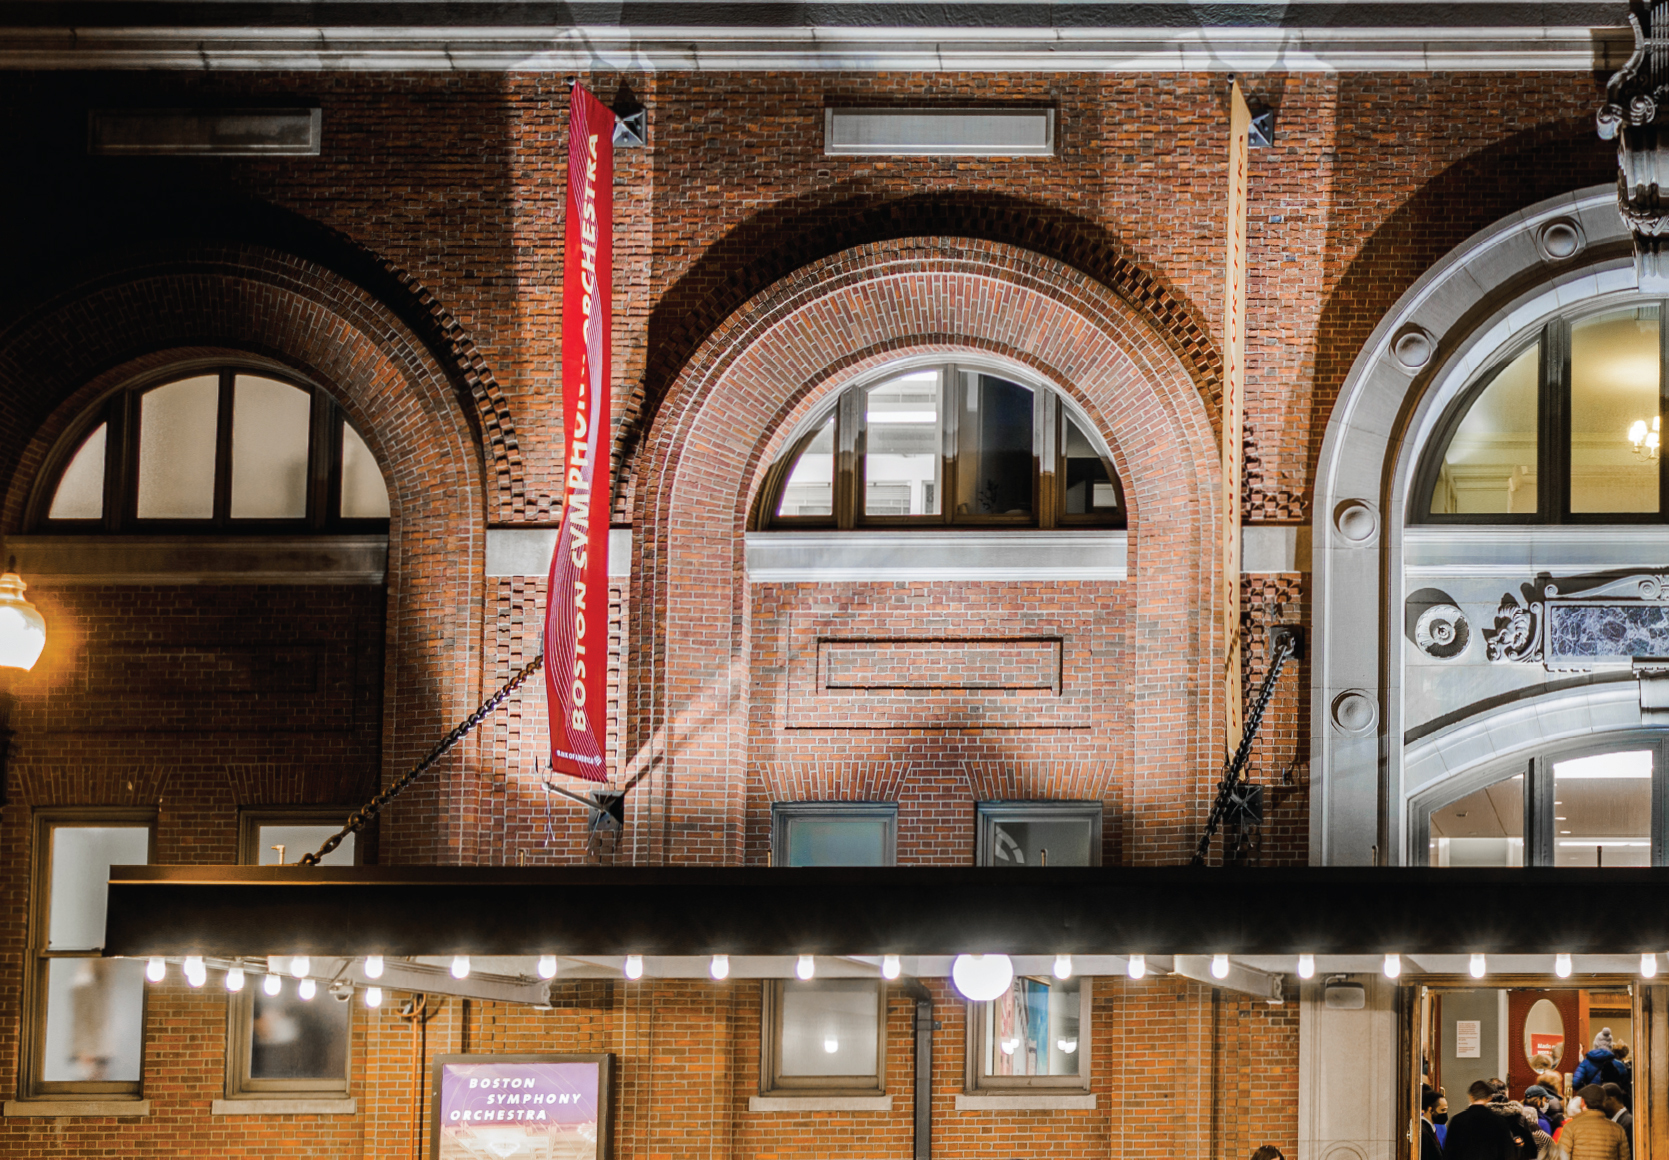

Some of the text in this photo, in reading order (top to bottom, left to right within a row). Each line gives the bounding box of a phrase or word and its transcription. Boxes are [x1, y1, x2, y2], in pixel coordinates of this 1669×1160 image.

[572, 581, 587, 732] BOSTON
[469, 1078, 536, 1089] BOSTON
[486, 1093, 582, 1104] SYMPHONY
[450, 1110, 547, 1122] ORCHESTRA
